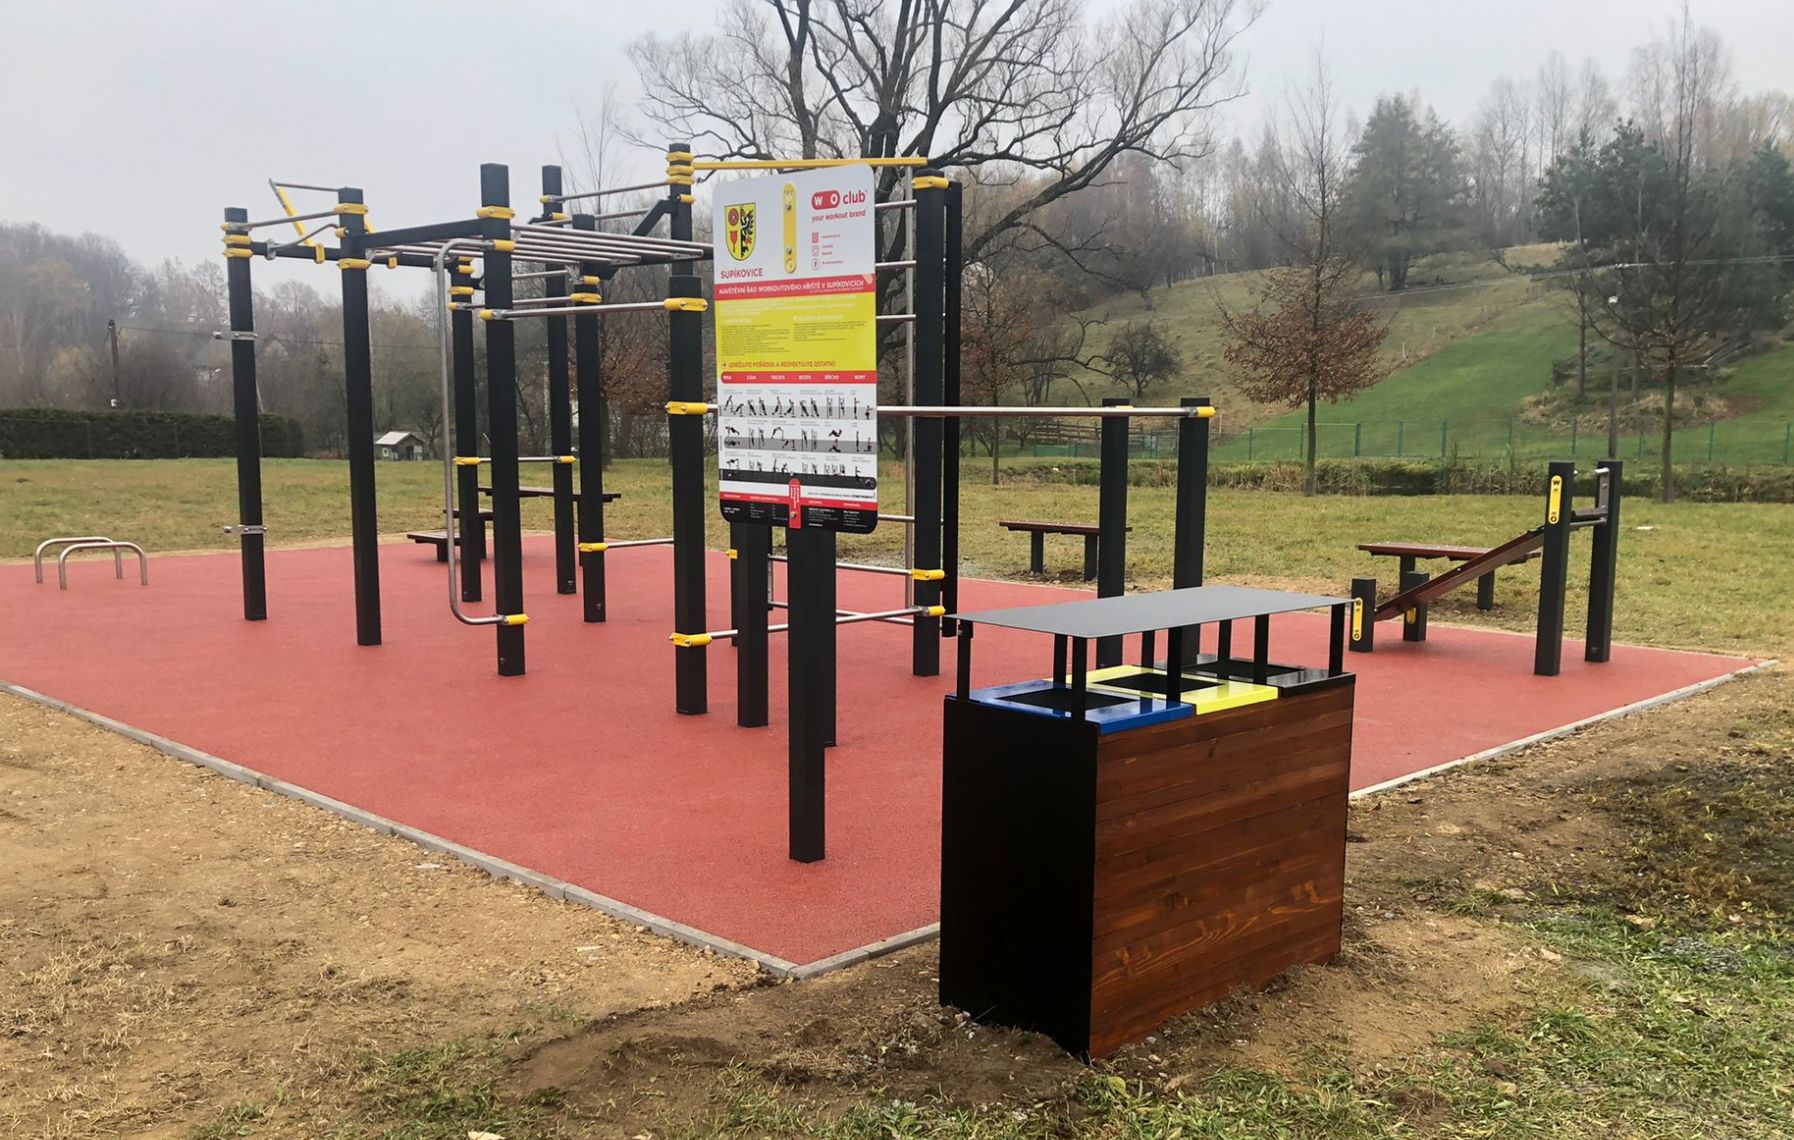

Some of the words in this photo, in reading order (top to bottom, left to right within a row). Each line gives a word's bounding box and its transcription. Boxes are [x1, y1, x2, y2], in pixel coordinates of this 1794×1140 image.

[842, 190, 866, 204] club
[812, 215, 824, 223] your
[825, 211, 848, 220] workout
[849, 209, 867, 218] brand
[720, 267, 763, 279] SUPÍKOVICE
